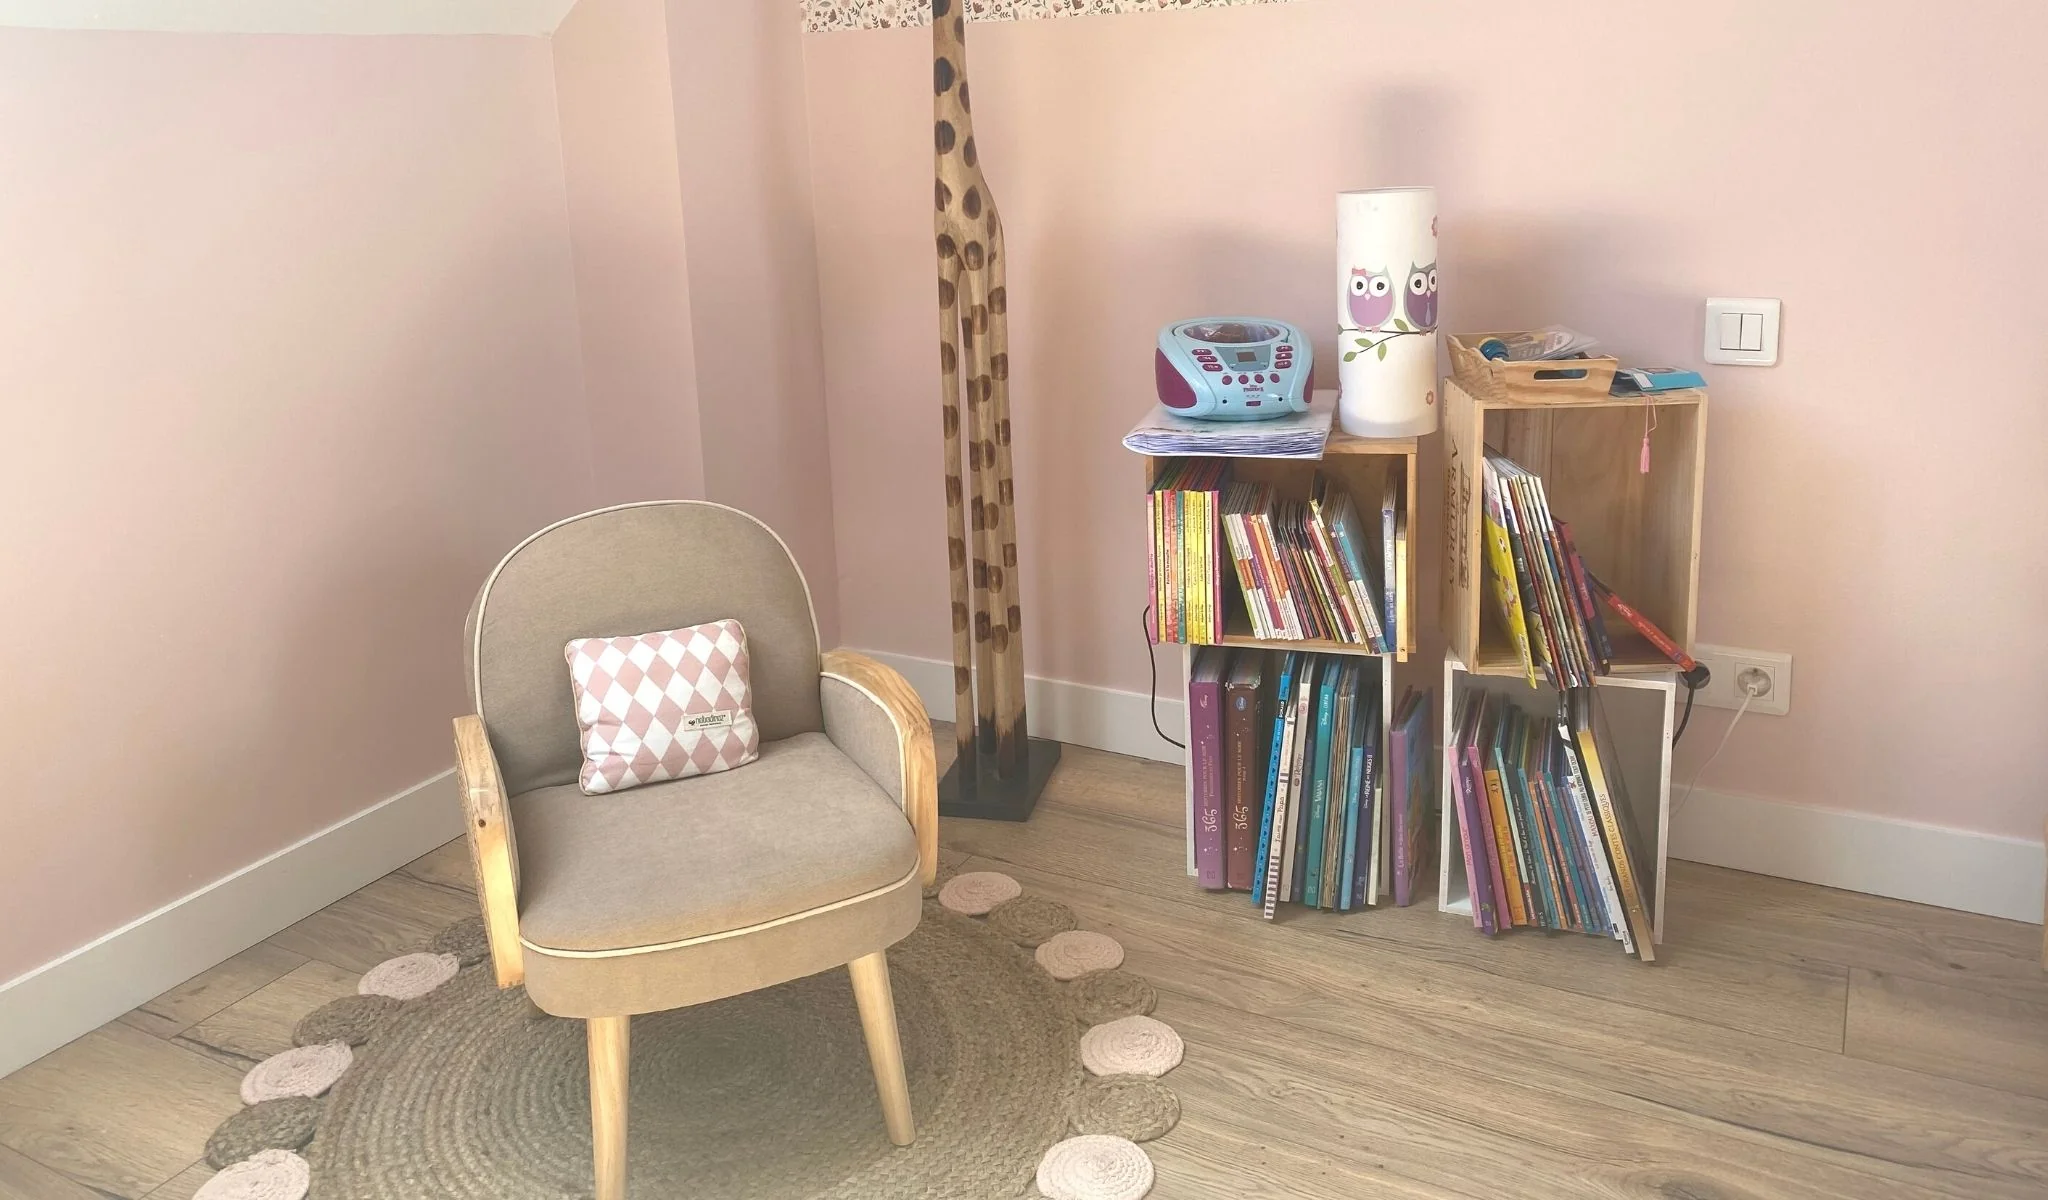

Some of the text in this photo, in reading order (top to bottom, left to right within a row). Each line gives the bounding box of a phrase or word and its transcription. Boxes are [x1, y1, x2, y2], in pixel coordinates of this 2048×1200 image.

[1202, 808, 1218, 833] 365
[1232, 804, 1249, 829] 365
[1598, 792, 1615, 833] CLASSIQUES
[1609, 832, 1623, 860] CONTES
[1617, 858, 1631, 889] GRANDS
